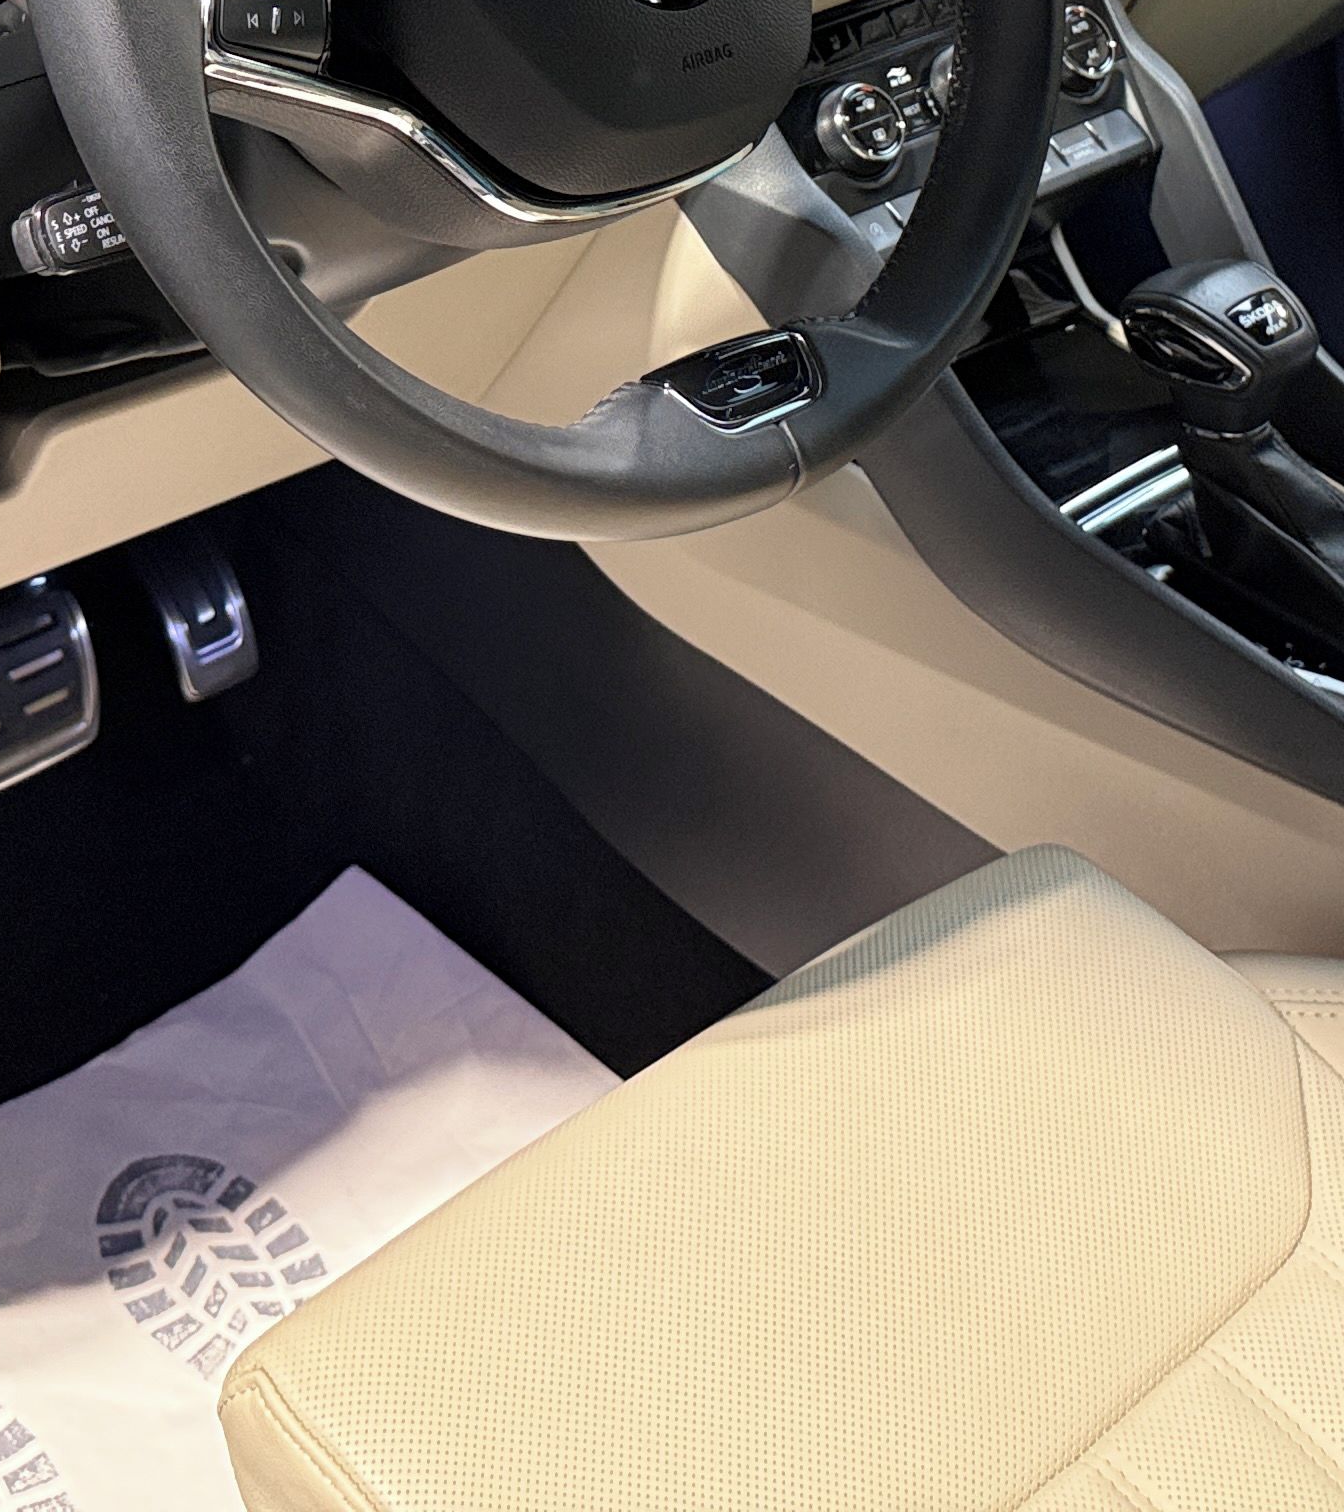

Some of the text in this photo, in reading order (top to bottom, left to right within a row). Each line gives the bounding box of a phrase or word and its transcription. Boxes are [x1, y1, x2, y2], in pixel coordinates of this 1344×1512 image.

[682, 43, 733, 73] AIRBAG
[84, 205, 99, 218] OFF
[63, 223, 88, 239] SPEED
[96, 226, 111, 239] ON
